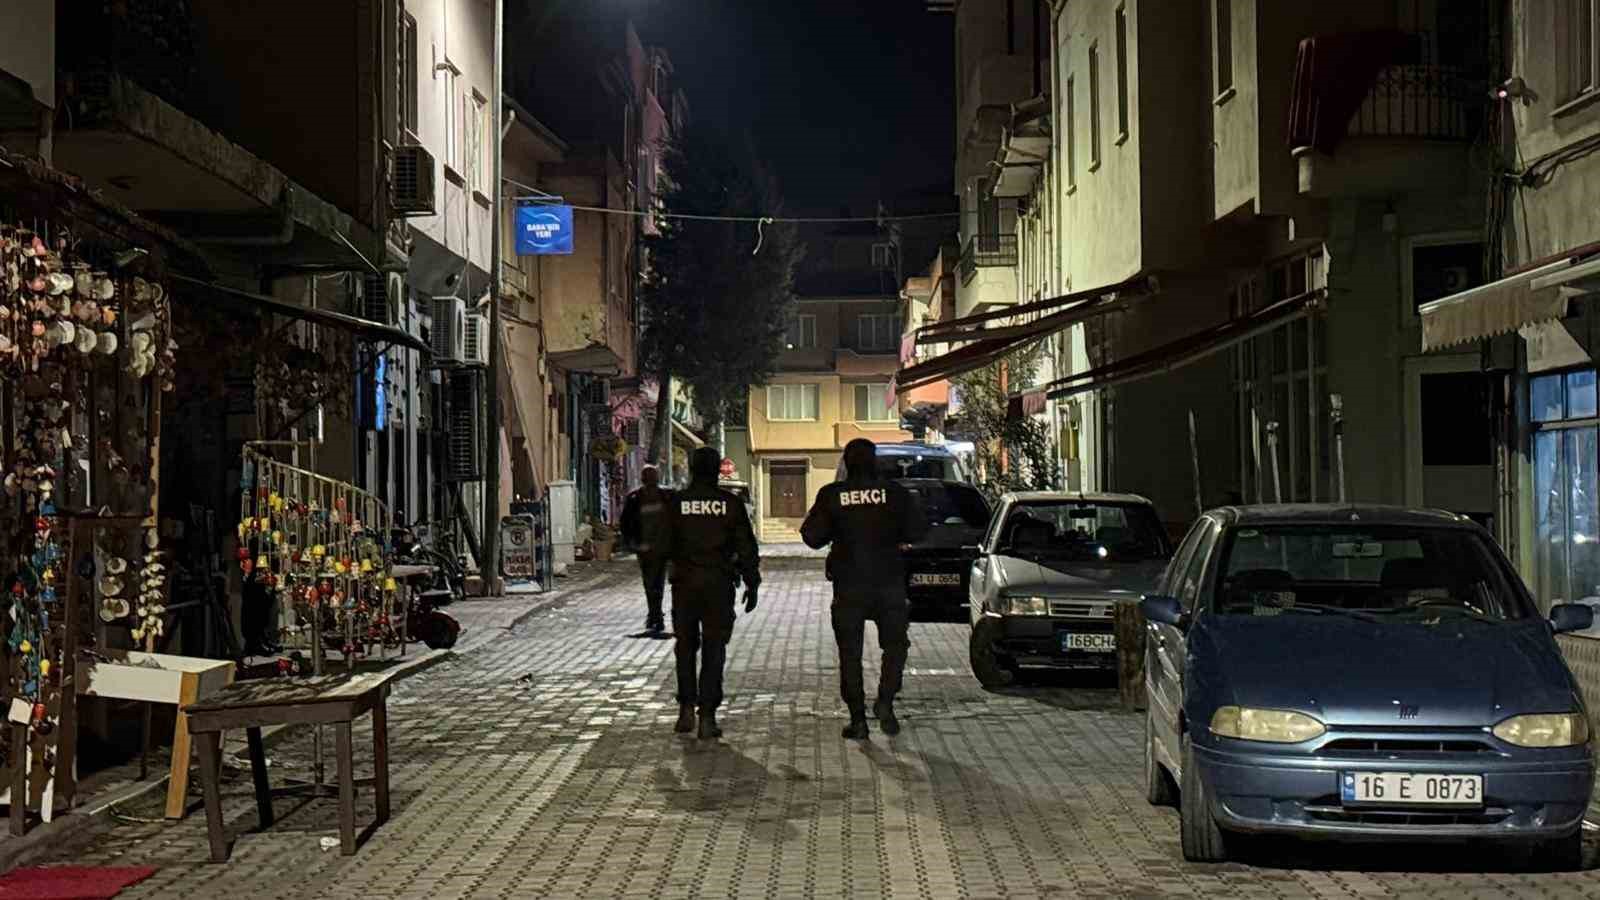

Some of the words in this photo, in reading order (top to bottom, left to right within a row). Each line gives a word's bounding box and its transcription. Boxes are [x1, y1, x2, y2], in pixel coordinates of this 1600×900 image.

[839, 488, 887, 506] BEKÇİ
[680, 500, 727, 516] BEKÇİ
[1361, 776, 1384, 798] 16
[1400, 777, 1411, 799] E
[1426, 778, 1476, 800] 0873
